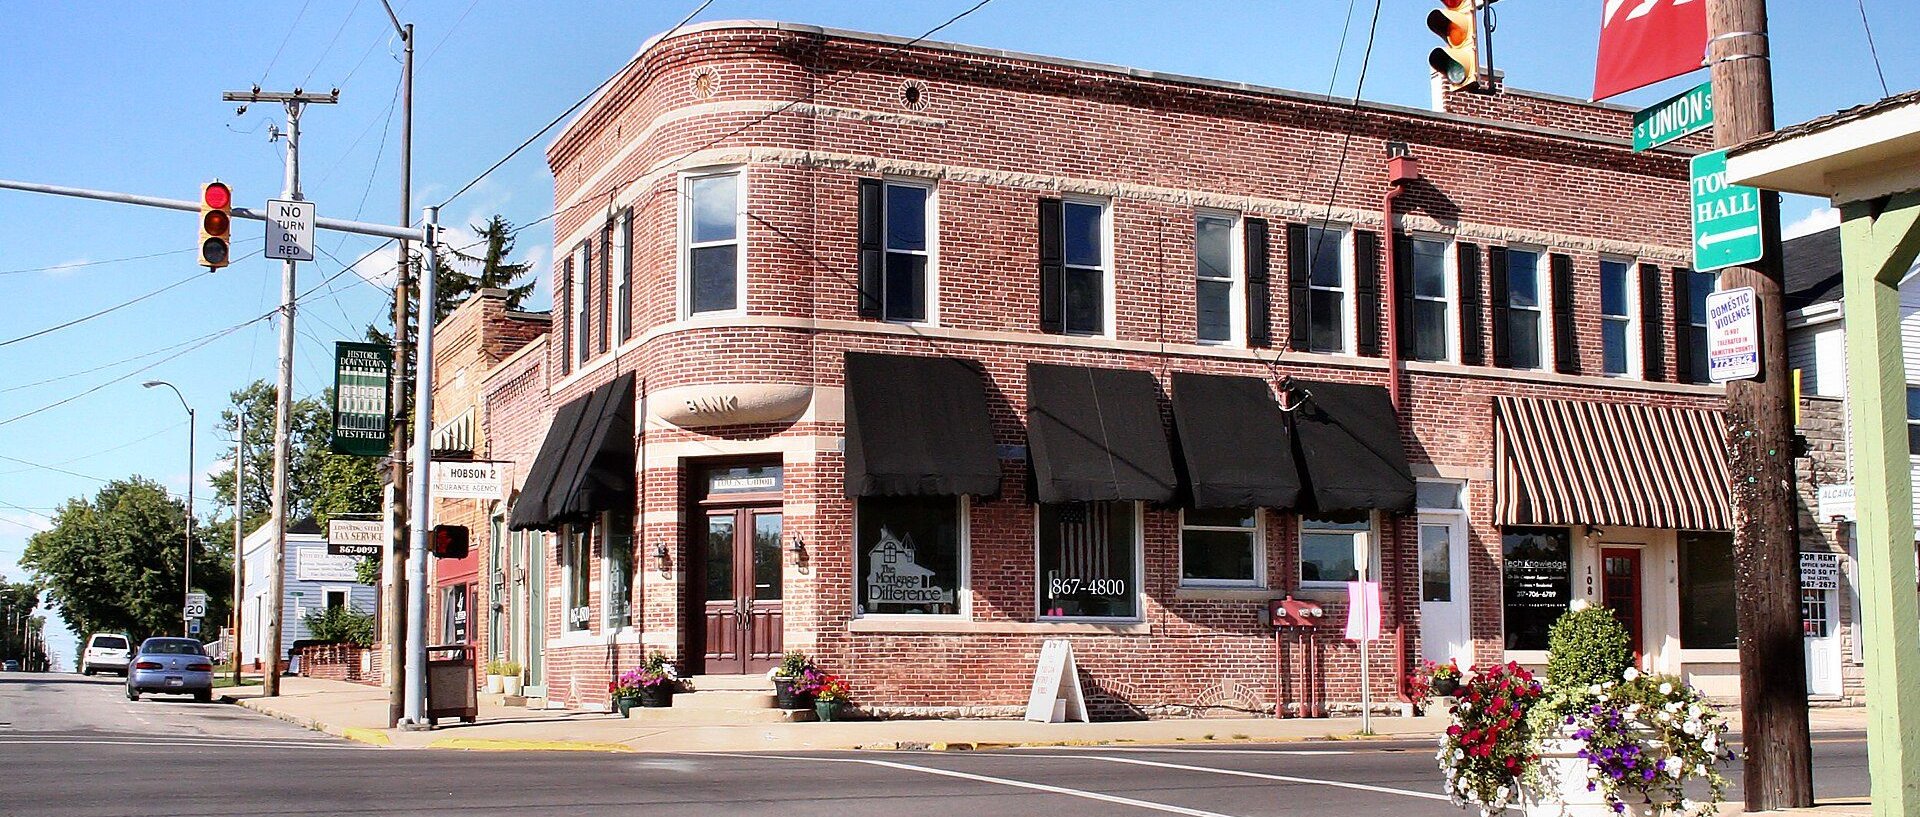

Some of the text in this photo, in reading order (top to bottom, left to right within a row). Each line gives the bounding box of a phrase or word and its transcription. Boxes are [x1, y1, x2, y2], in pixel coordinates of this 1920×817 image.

[1637, 122, 1644, 138] S
[1648, 90, 1703, 140] UNION
[1694, 172, 1736, 196] TO
[280, 206, 300, 218] NO
[1696, 192, 1756, 224] HALL
[277, 220, 304, 230] TURN
[282, 233, 297, 242] ON
[279, 245, 300, 255] RED
[1710, 292, 1750, 319] DOMESTIC
[1715, 305, 1751, 330] VIOLENCE
[1717, 338, 1741, 346] TOLERATED
[347, 350, 381, 360] HISTORIC
[1712, 344, 1754, 356] HAMILTON COUNTY
[340, 357, 386, 368] DOWNTOWN
[686, 395, 738, 414] BANK
[337, 430, 386, 439] WESTFIELD
[450, 468, 486, 479] HOBSON
[490, 470, 496, 479] 2
[472, 484, 498, 492] AGENCY
[334, 532, 383, 541] TAX SERVICE
[339, 546, 378, 554] 867-0093
[881, 564, 896, 573] The
[1504, 559, 1567, 569] Tech Knowledge
[875, 572, 920, 588] Mortgage
[870, 584, 942, 600] Difference
[1052, 578, 1125, 595] 867-4800
[187, 605, 203, 614] 20
